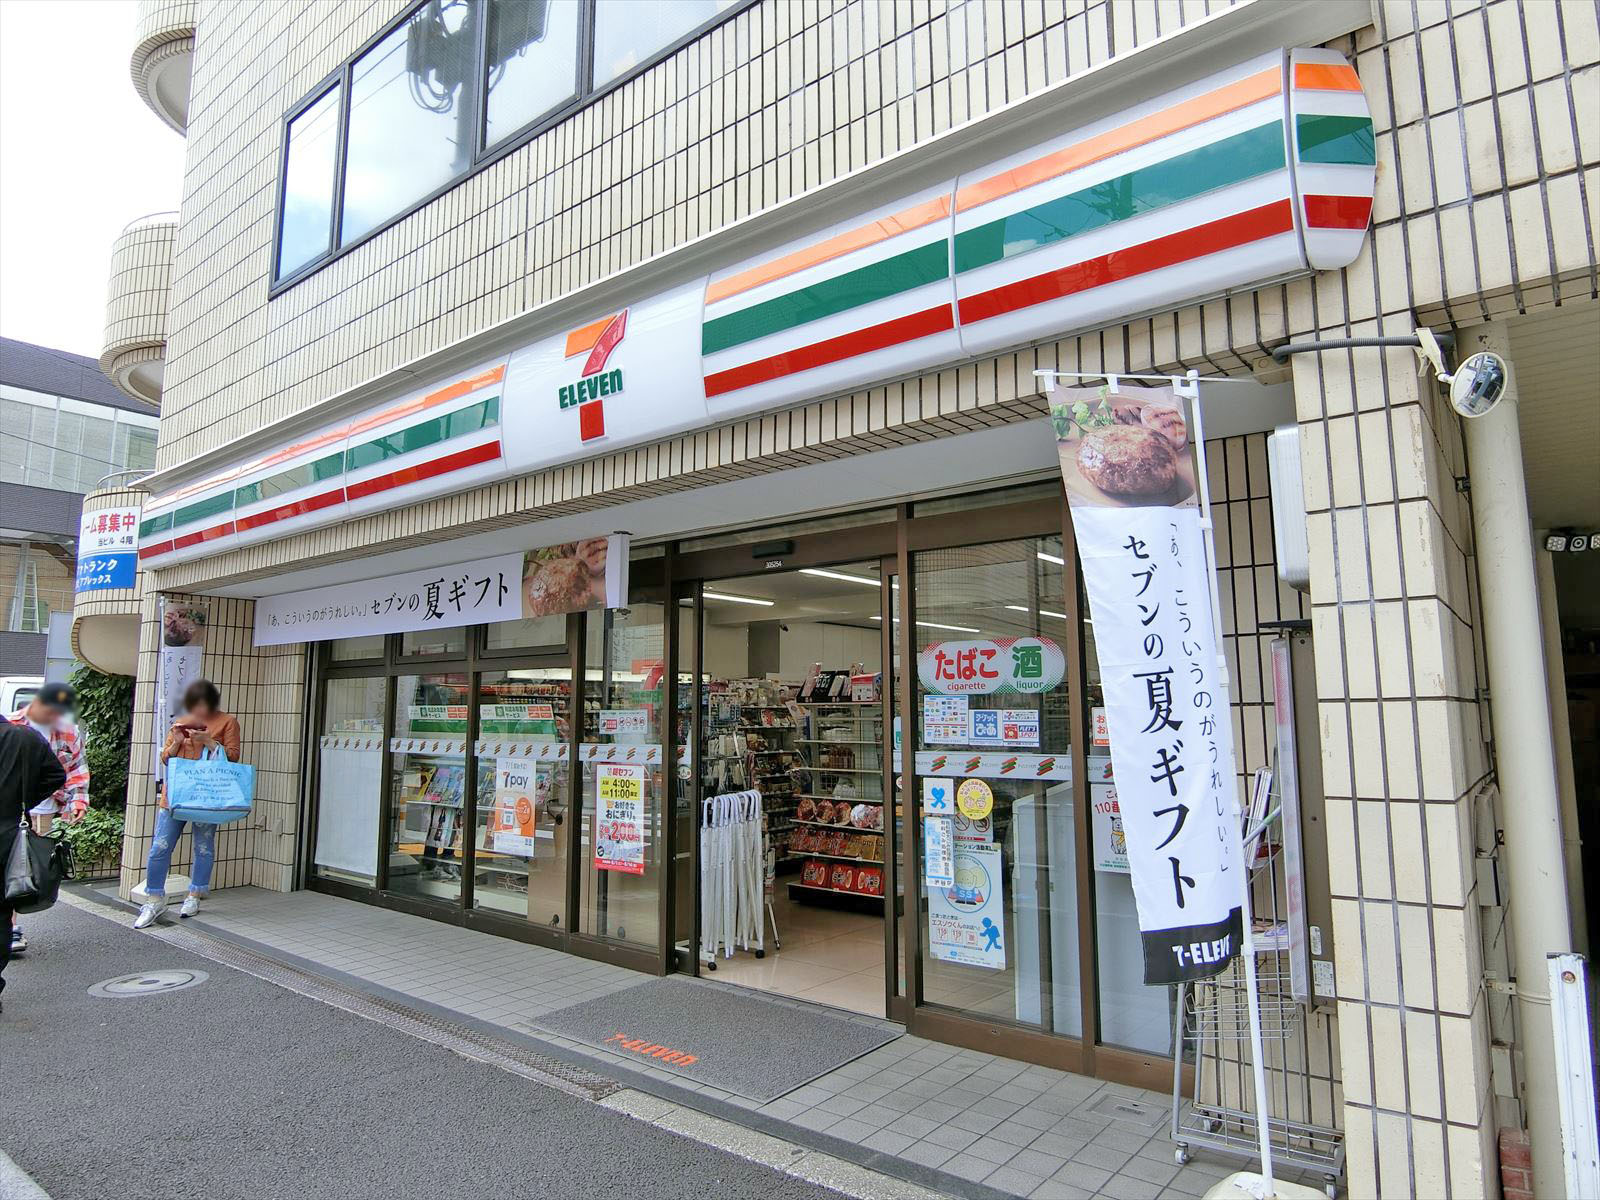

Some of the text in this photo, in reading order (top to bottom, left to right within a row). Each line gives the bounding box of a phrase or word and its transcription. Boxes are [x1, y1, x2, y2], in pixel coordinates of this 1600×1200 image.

[371, 572, 509, 622] セブンの夏ギフト
[935, 645, 1043, 681] たばこ 酒
[947, 680, 1044, 691] cigarette liquor
[1121, 534, 1196, 910] セブンの夏ギフト
[184, 768, 206, 776] PLAN
[215, 767, 242, 778] PICNIC
[502, 771, 529, 789] 7pay
